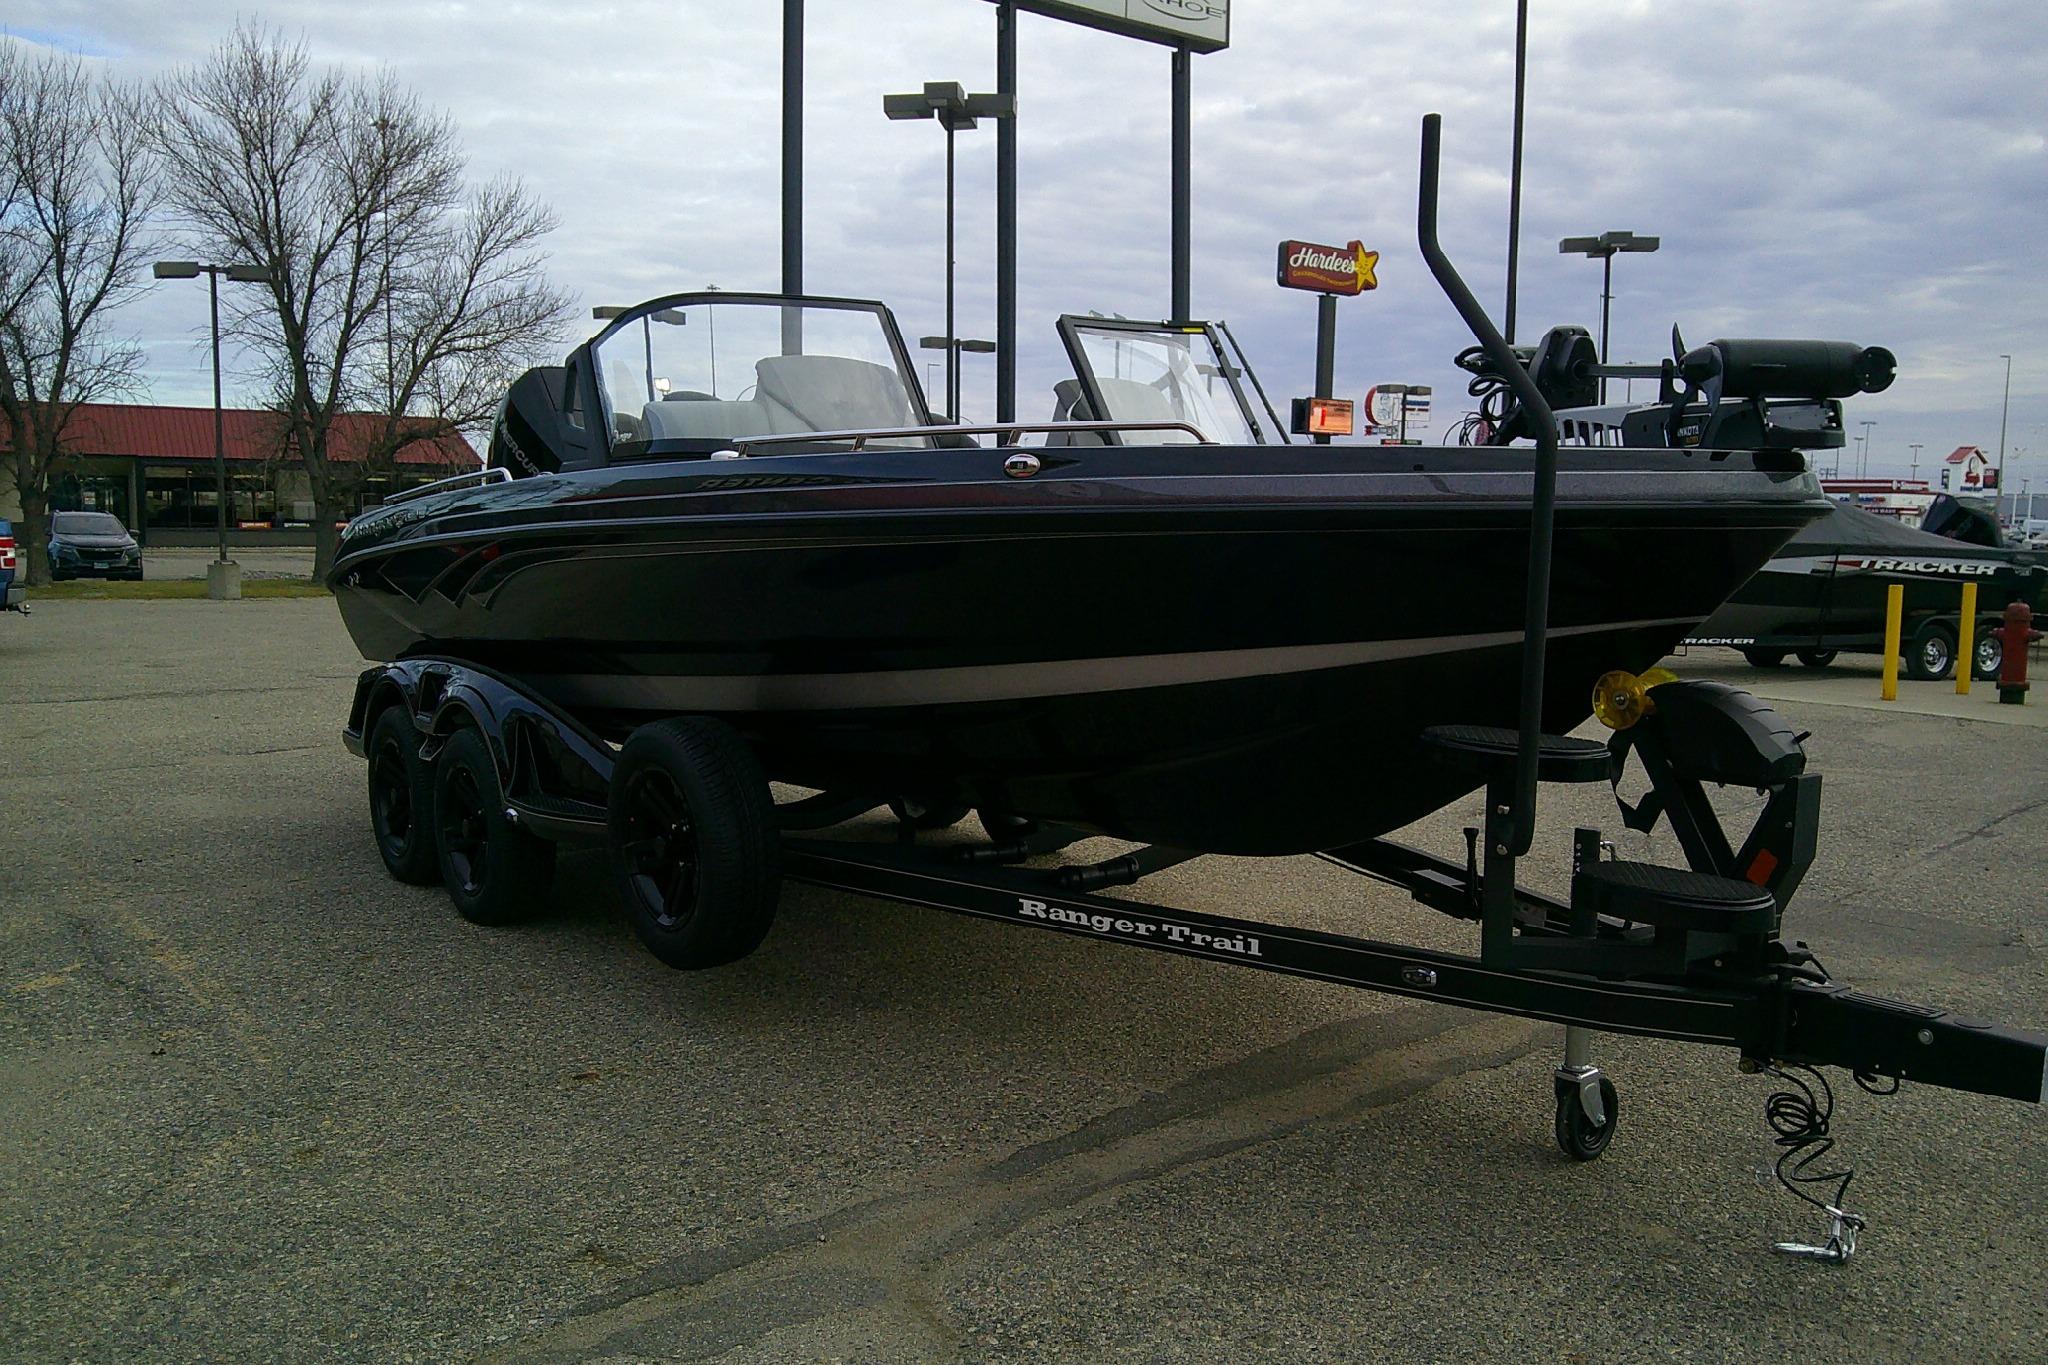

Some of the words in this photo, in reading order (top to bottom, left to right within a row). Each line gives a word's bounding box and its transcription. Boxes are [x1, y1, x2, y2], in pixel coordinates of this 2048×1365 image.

[1160, 0, 1224, 18] HOE
[1289, 247, 1357, 274] Hardee's
[1860, 558, 1996, 576] TRACKER
[1018, 898, 1157, 937] Ranger
[1162, 923, 1263, 957] Trail
